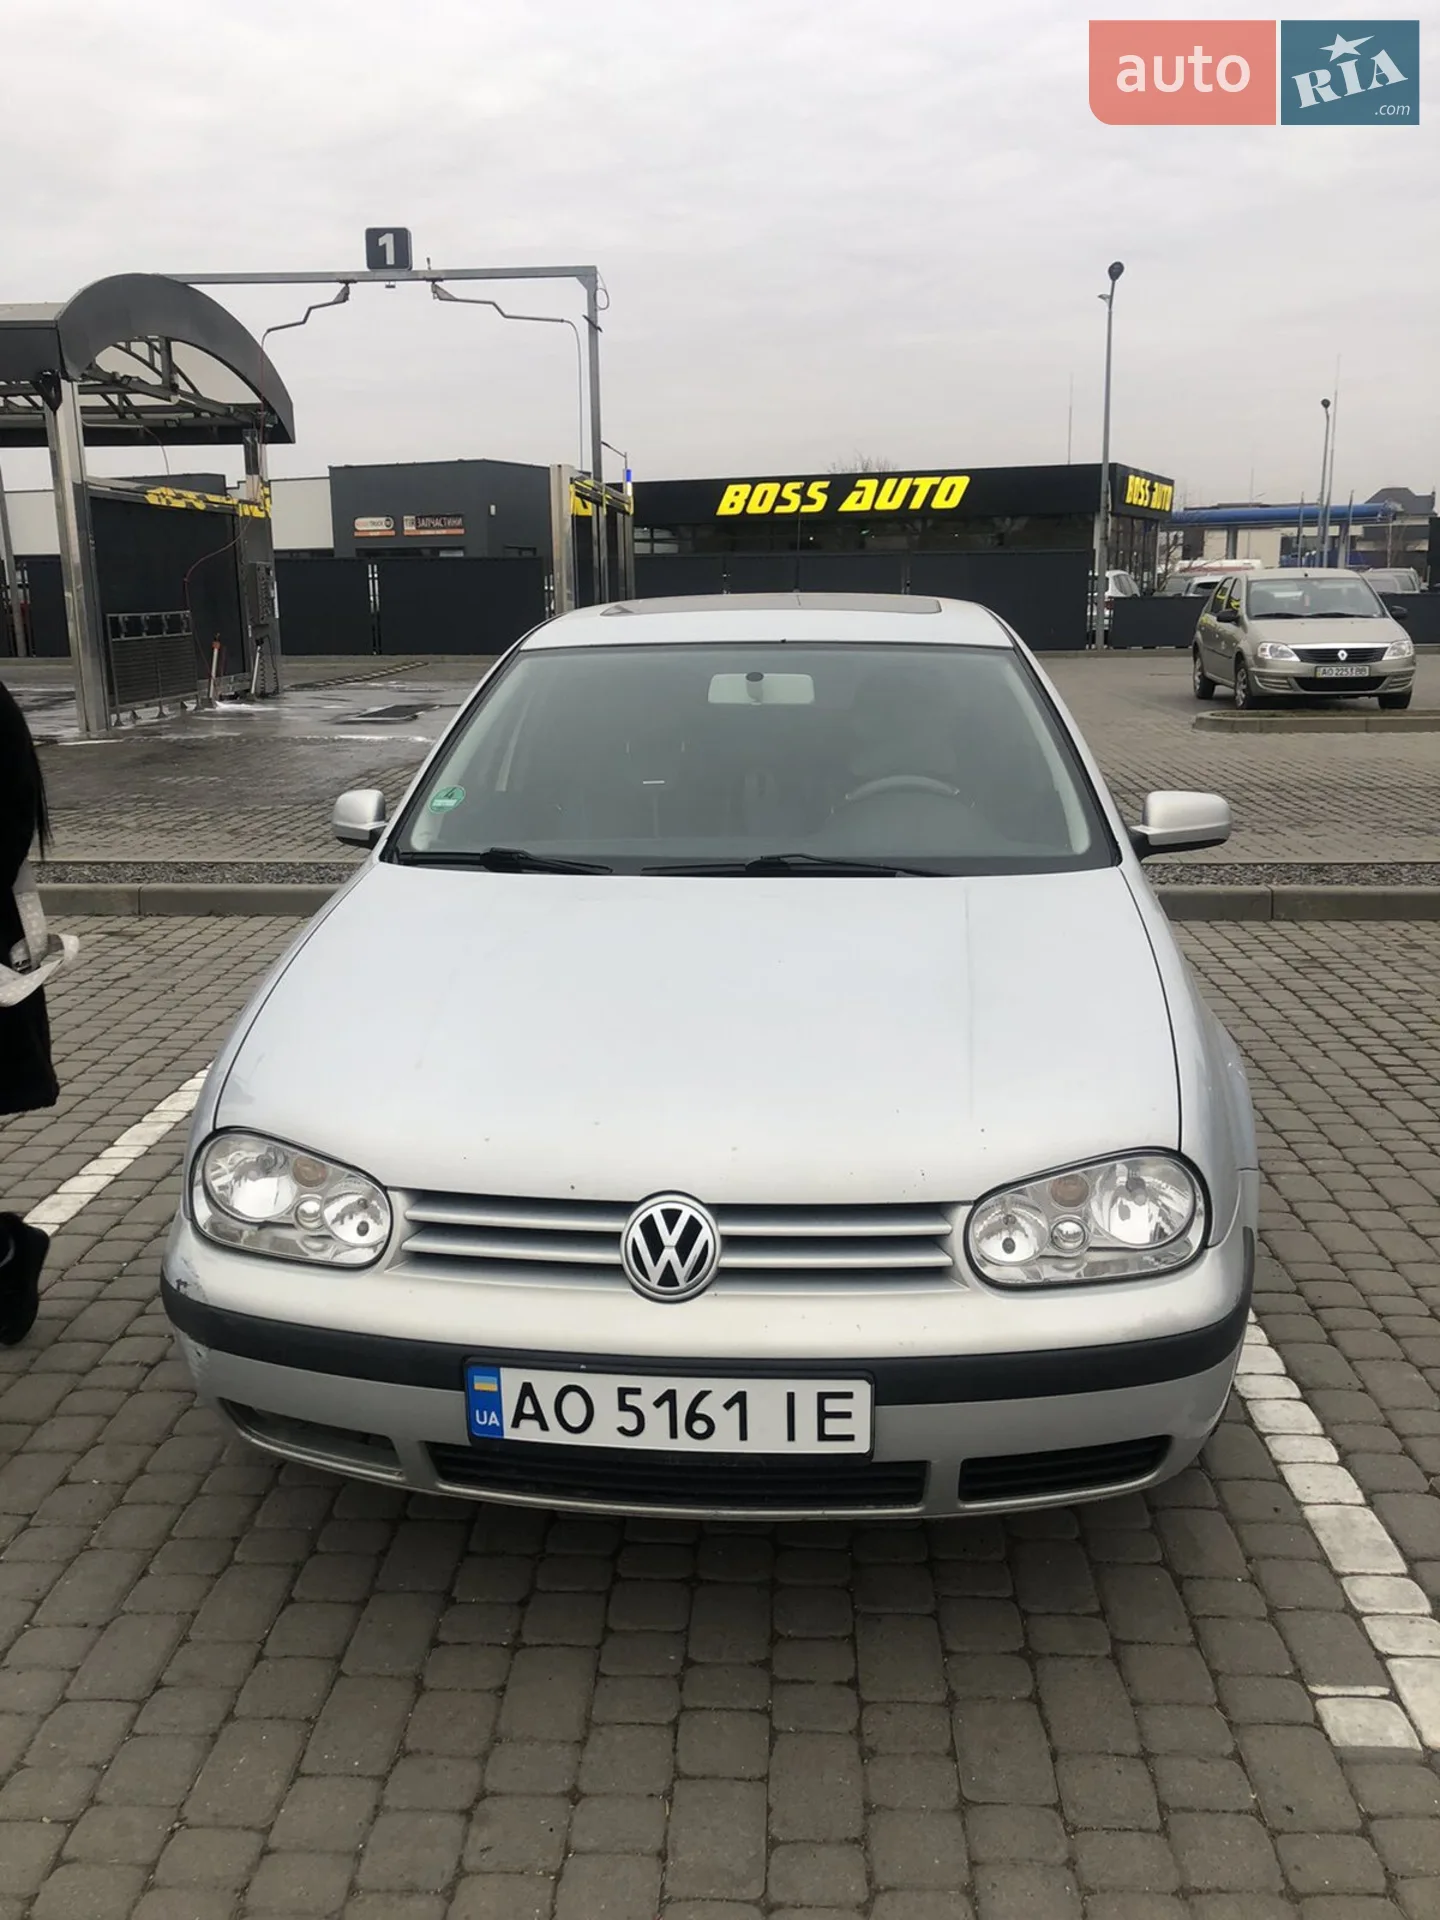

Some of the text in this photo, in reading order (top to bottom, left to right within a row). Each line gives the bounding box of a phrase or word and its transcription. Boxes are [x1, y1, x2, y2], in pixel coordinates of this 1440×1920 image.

[378, 233, 395, 264] 1
[715, 475, 971, 515] BOSS AUTO
[1125, 474, 1151, 507] BOSS
[417, 516, 463, 528] ЗАПЧАСТИНИ
[475, 1409, 500, 1427] UA
[510, 1381, 855, 1442] AO 5161 IE
